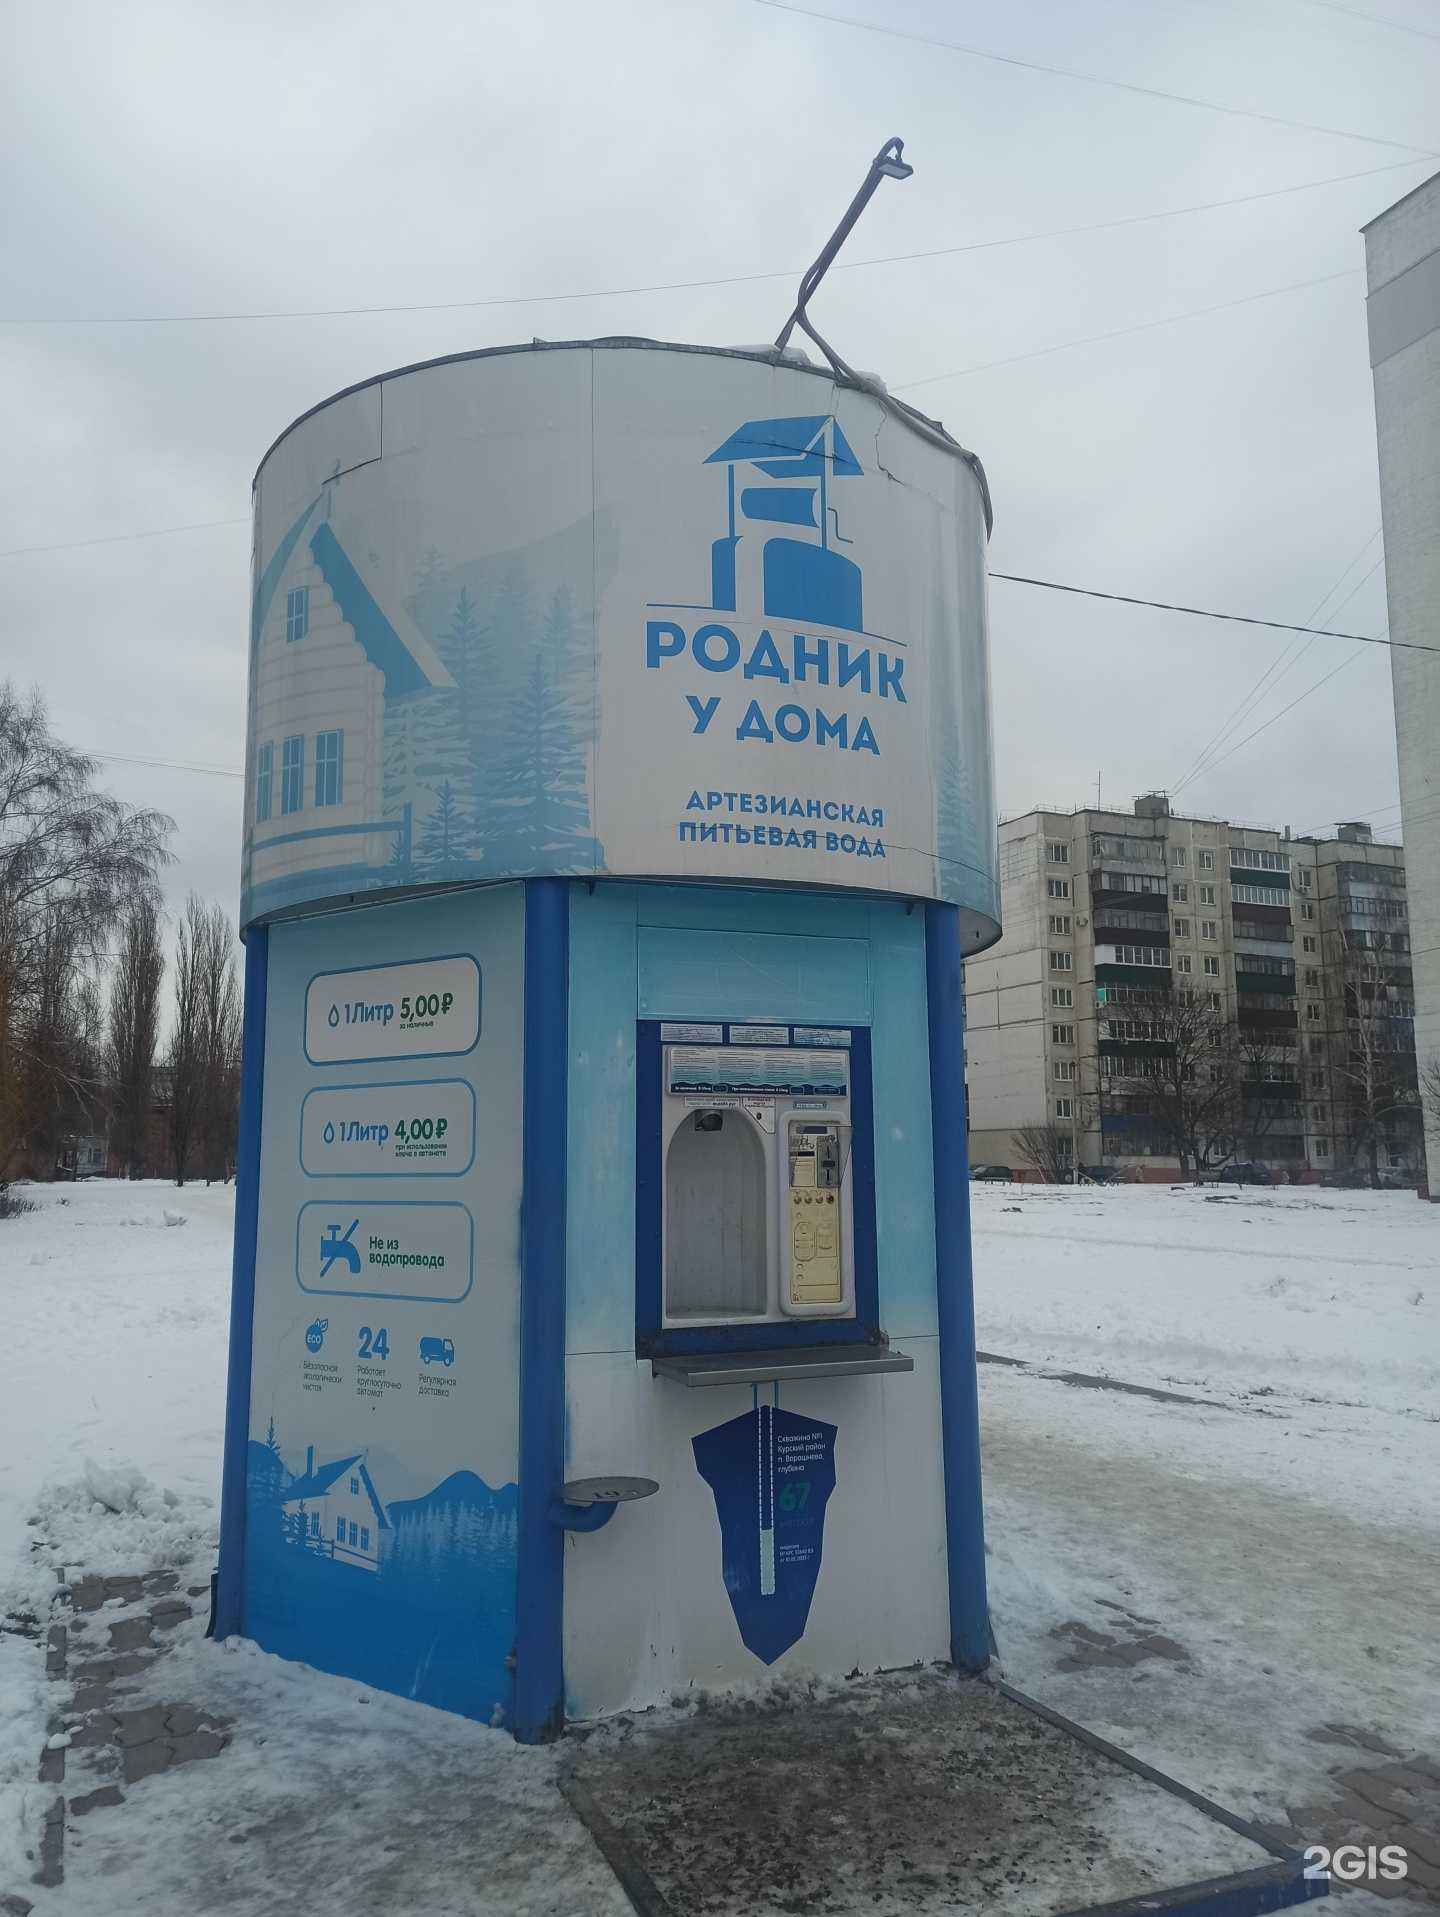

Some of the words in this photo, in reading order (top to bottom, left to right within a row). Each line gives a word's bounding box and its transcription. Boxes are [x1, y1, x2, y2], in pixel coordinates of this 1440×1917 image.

[646, 621, 907, 703] РОДНИК
[685, 695, 721, 734] У
[736, 699, 881, 755] ДОМА
[685, 790, 885, 828] АРТЕЗИАНСКАЯ
[678, 821, 818, 850] ПИТЬЕВАЯ
[825, 831, 887, 858] ВОДА
[351, 1001, 394, 1026] Литр
[346, 1120, 389, 1146] Литр
[369, 1236, 384, 1249] Не
[386, 1239, 399, 1250] из
[369, 1252, 445, 1269] водопровода
[358, 1326, 390, 1360] 24
[418, 1373, 457, 1386] Регулярная
[777, 1434, 811, 1443] Скважина
[777, 1443, 804, 1453] Курский
[805, 1442, 826, 1452] район
[779, 1482, 811, 1512] 67
